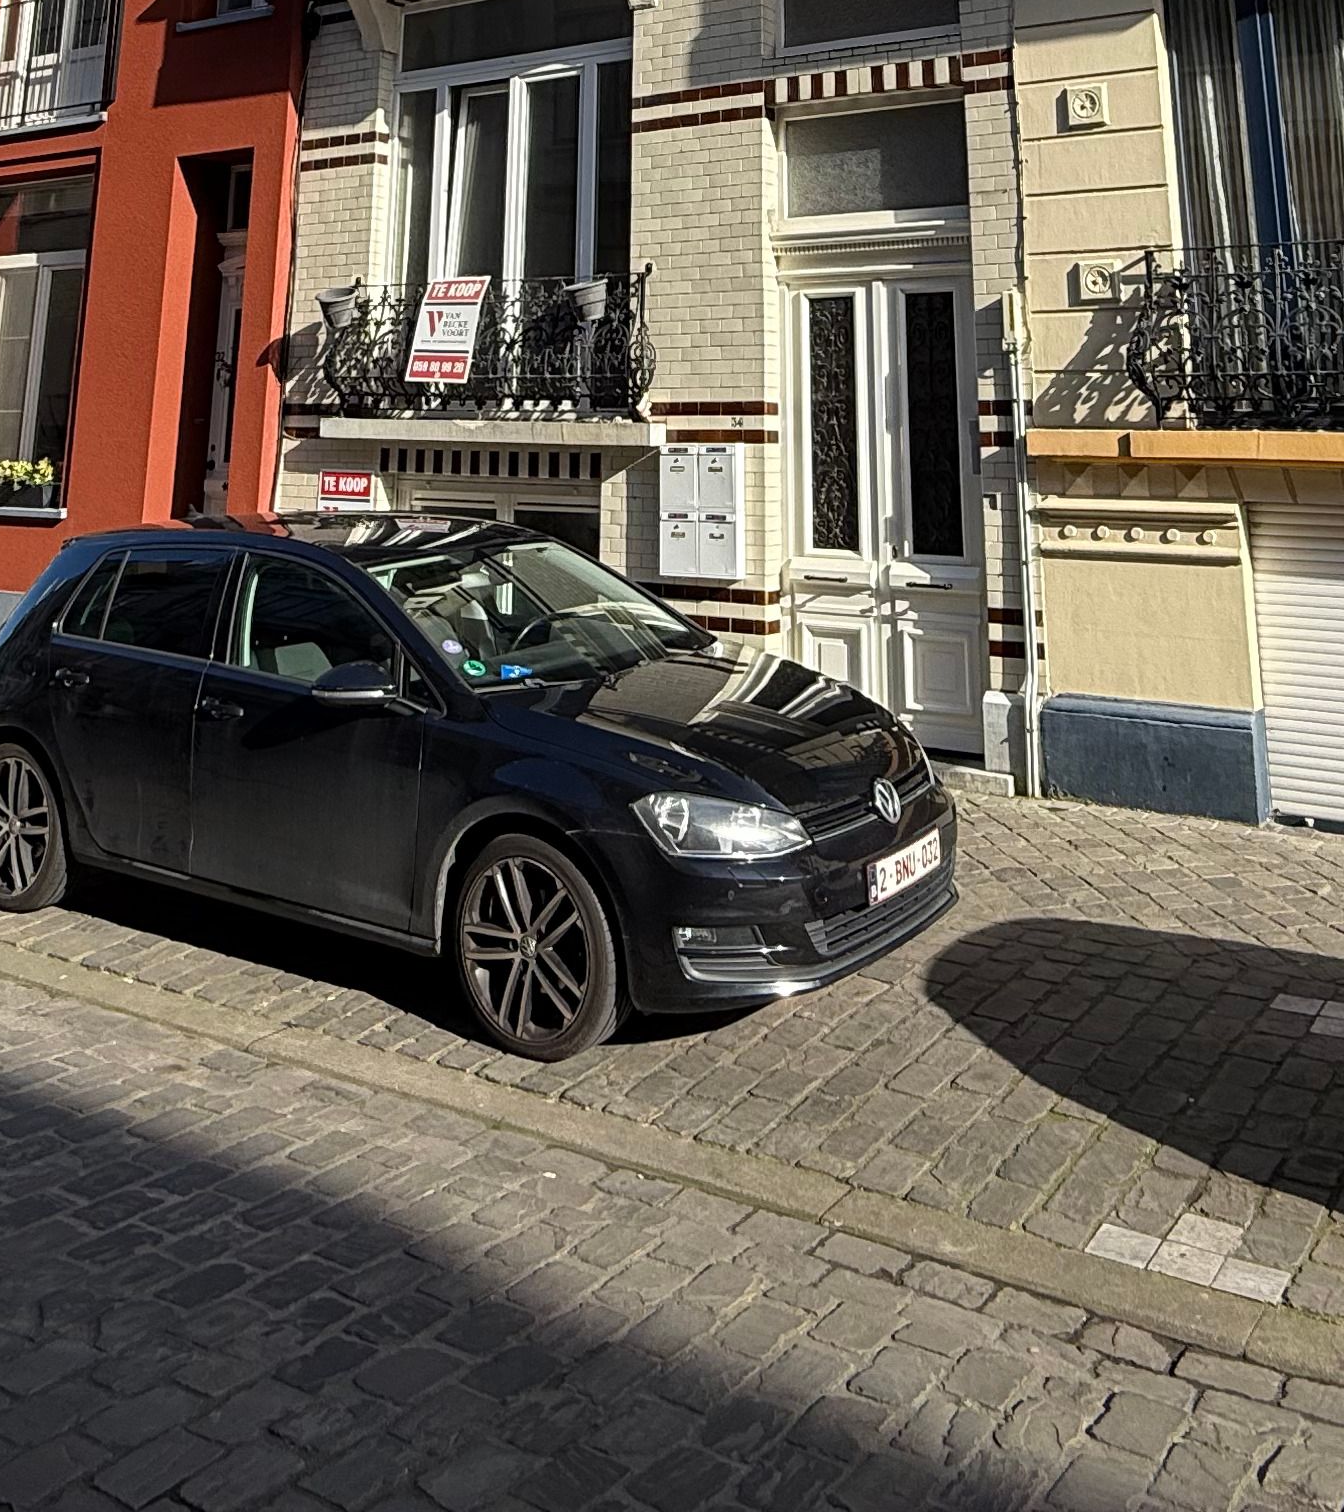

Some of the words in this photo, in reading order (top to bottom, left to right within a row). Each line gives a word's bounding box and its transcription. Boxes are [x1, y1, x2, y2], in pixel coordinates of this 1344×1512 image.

[431, 283, 448, 297] TE
[447, 283, 482, 297] KOOP
[730, 416, 744, 428] 34
[323, 476, 337, 492] TE
[338, 476, 369, 493] KOOP
